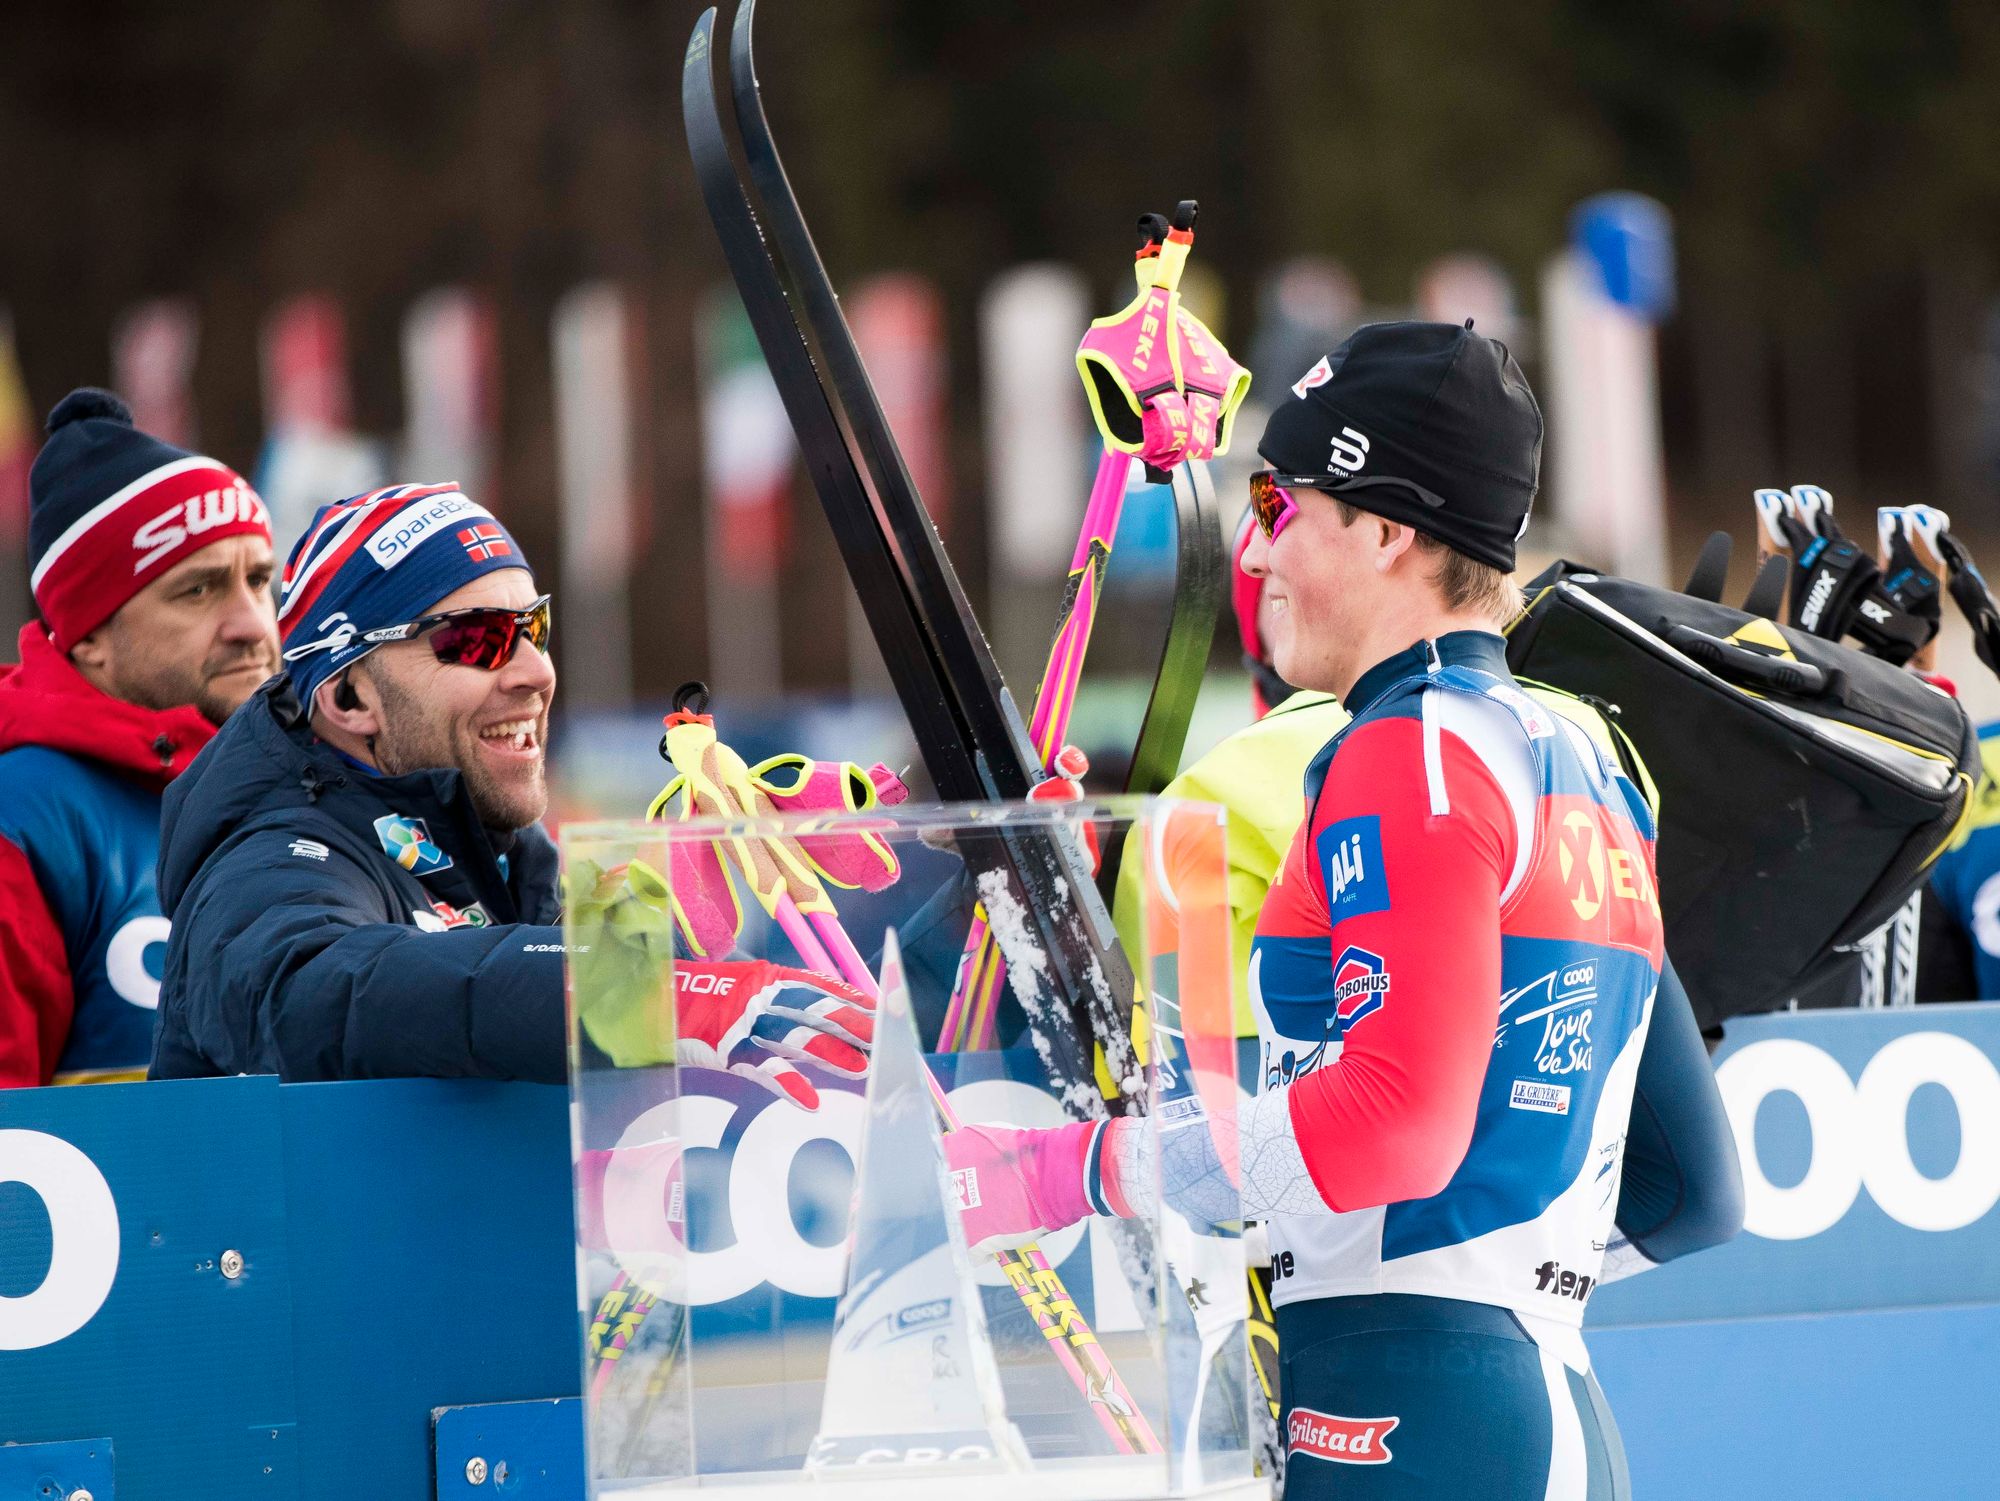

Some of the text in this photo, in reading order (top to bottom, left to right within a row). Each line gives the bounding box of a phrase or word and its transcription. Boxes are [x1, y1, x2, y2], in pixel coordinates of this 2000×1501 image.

[1132, 296, 1165, 372] LEKI
[1563, 965, 1594, 987] coop
[1538, 1049, 1562, 1074] de
[1514, 1084, 1526, 1098] LE
[1016, 1241, 1098, 1347] LEKI
[1290, 1417, 1376, 1454] Grilstad
